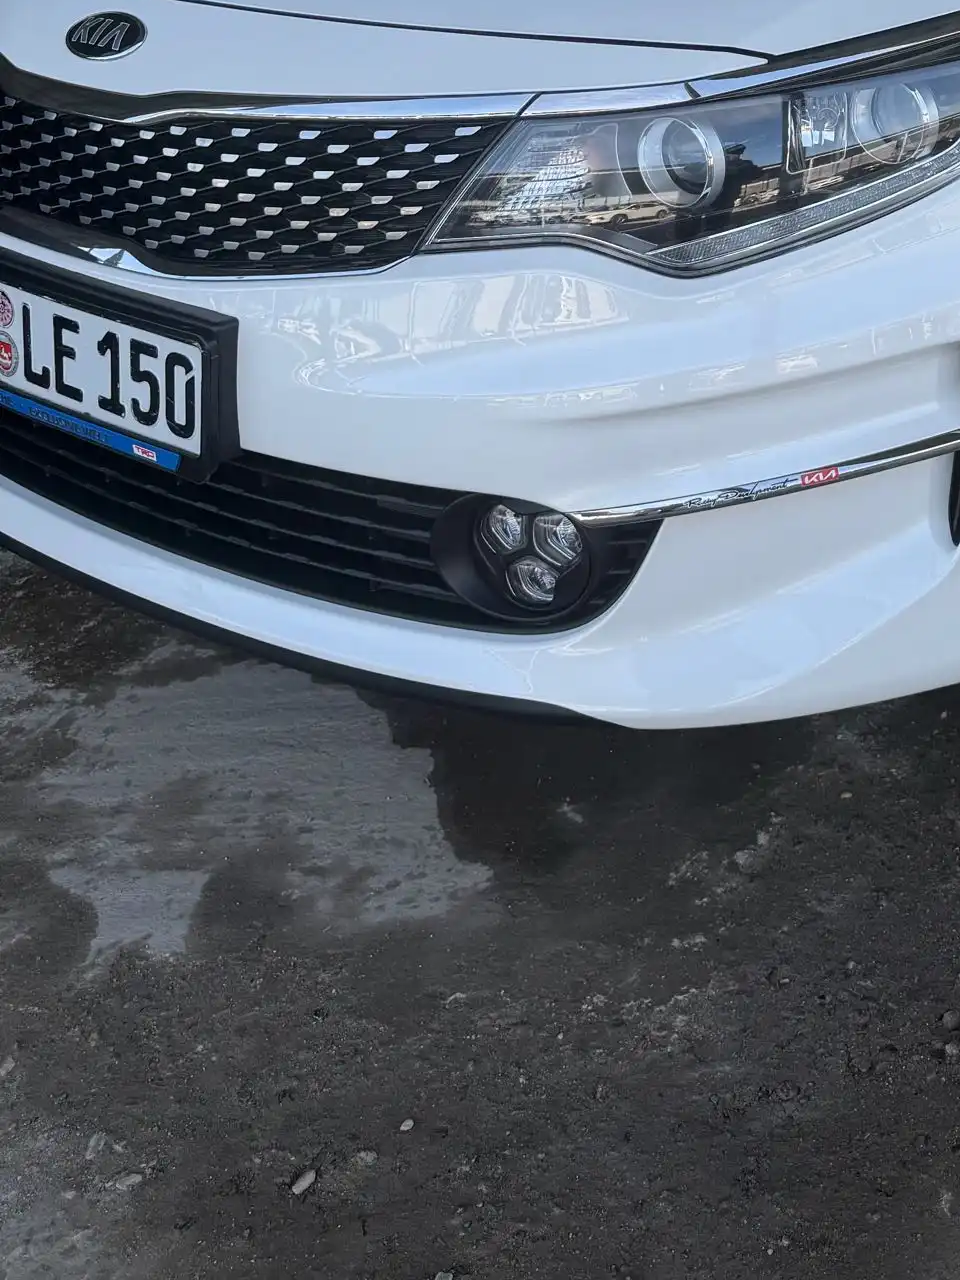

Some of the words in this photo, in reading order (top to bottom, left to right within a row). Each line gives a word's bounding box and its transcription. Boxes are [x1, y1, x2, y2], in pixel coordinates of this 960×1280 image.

[72, 17, 130, 50] KIA
[22, 303, 84, 403] LE
[97, 331, 196, 439] 150
[804, 469, 836, 485] KIA
